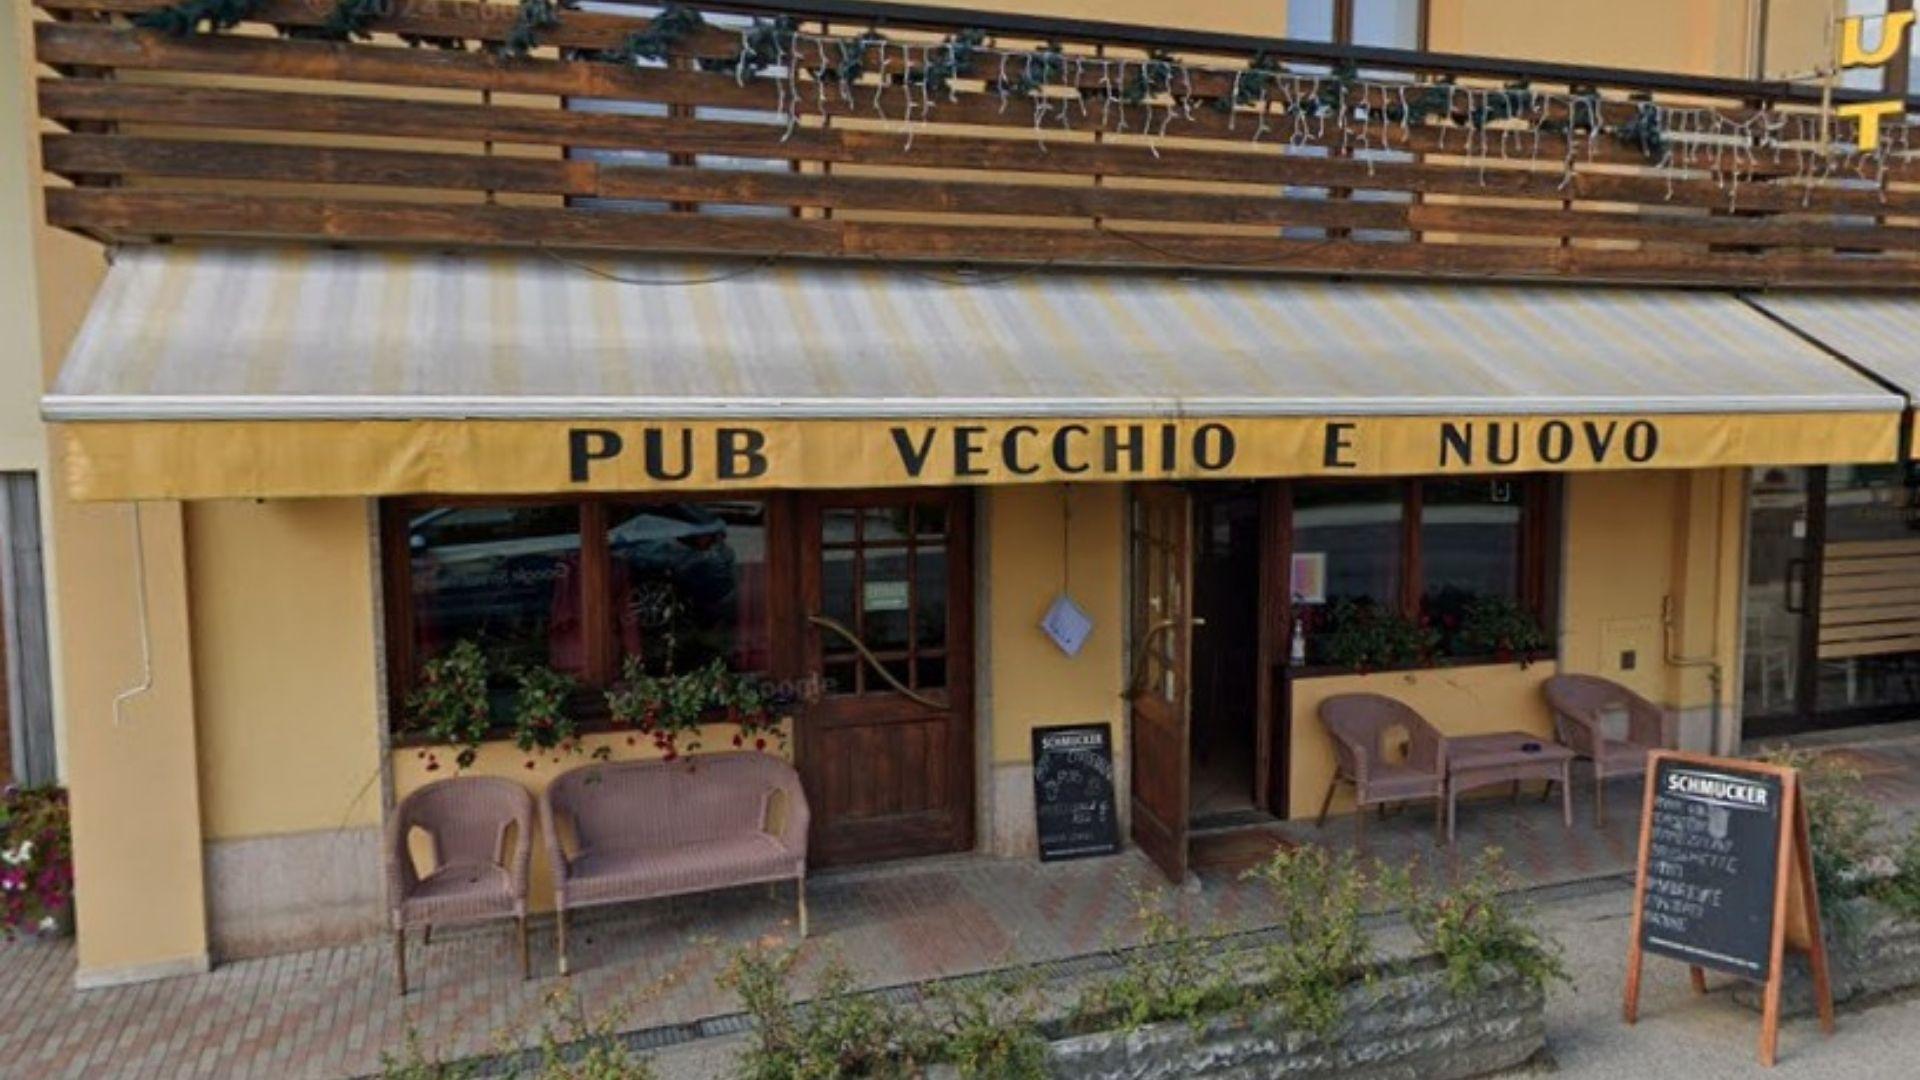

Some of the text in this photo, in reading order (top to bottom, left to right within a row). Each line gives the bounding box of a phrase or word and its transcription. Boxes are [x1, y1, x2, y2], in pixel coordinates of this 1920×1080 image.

[568, 419, 1660, 483] PUB VECCHIO E NUOVO
[1668, 774, 1768, 805] SCHMUCKER
